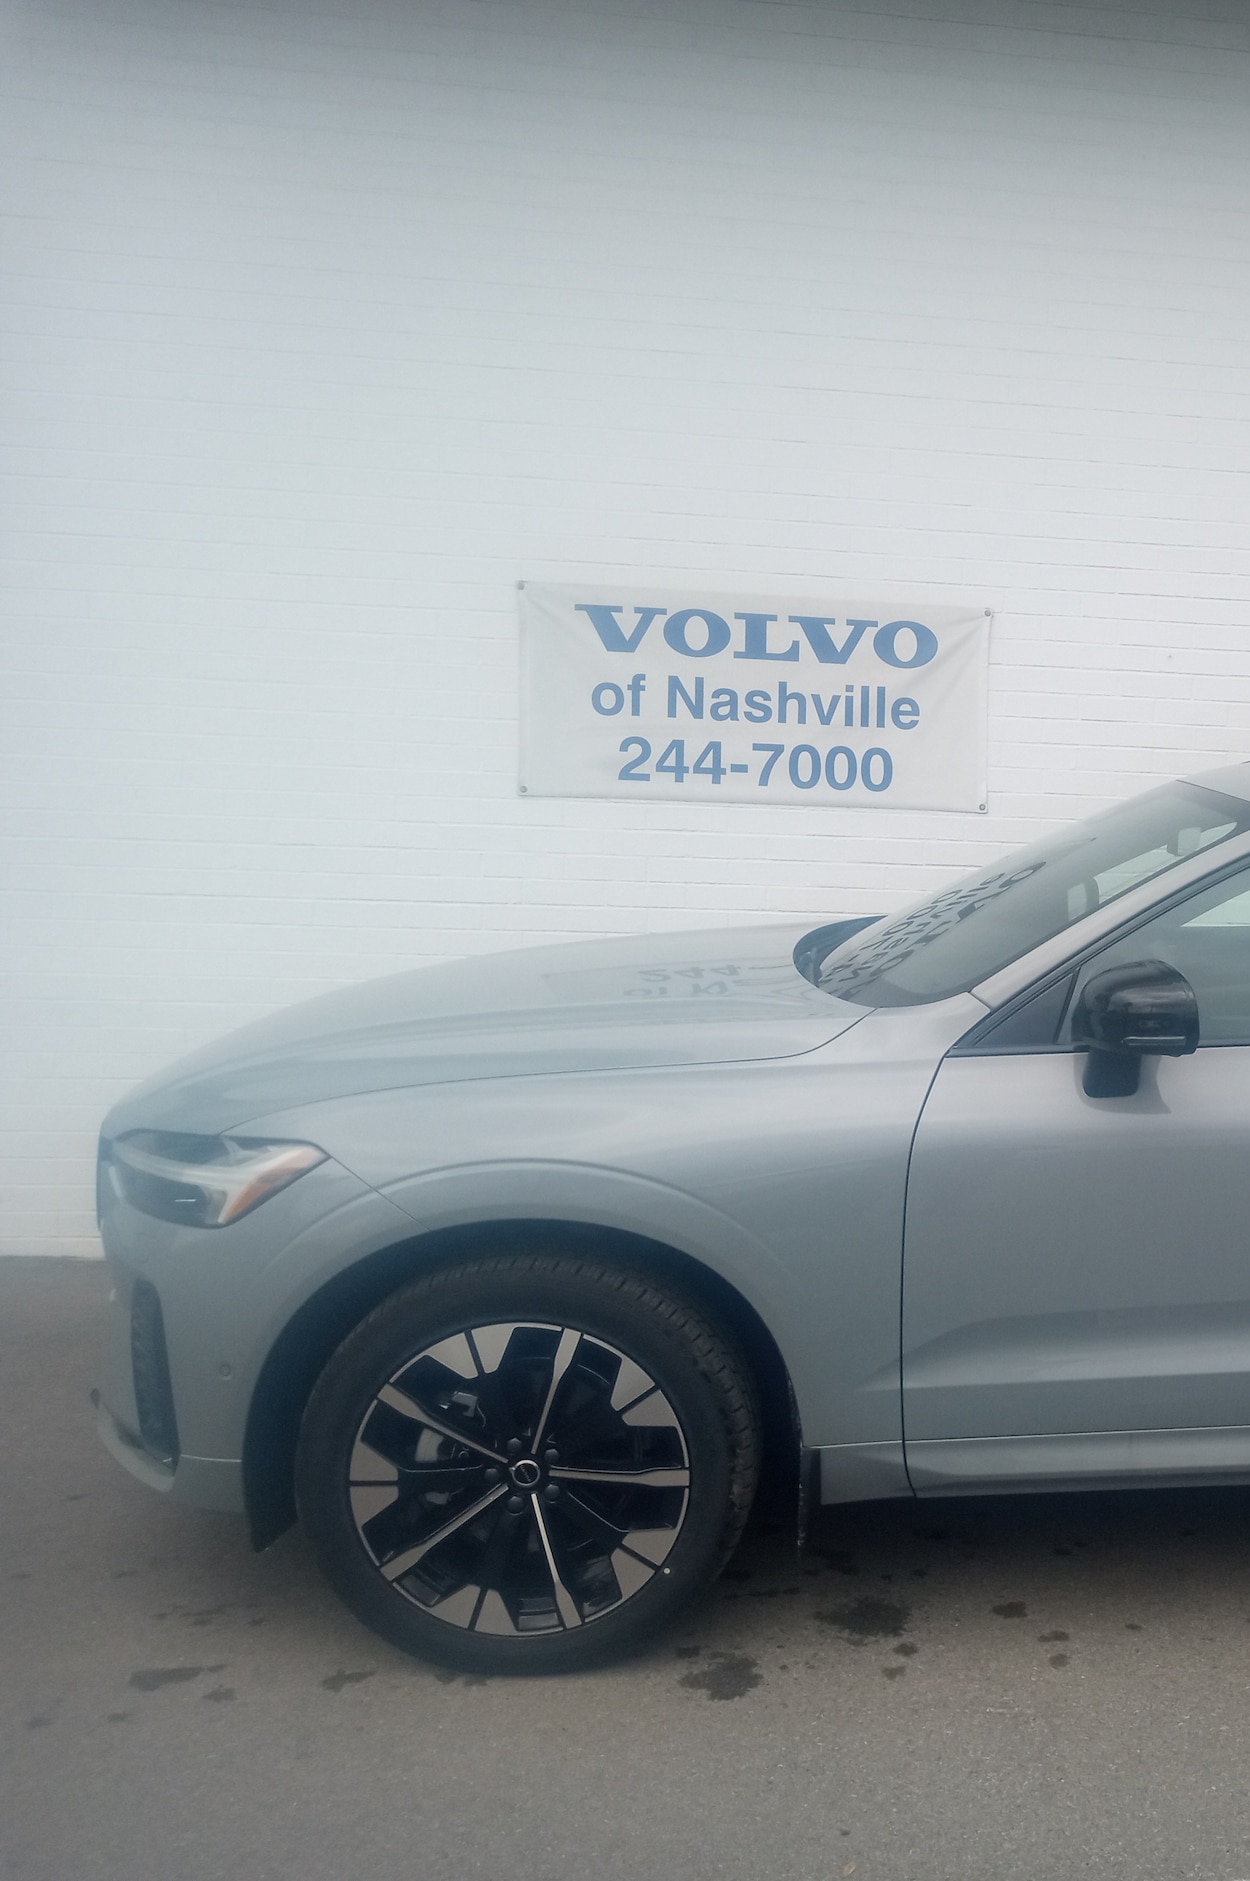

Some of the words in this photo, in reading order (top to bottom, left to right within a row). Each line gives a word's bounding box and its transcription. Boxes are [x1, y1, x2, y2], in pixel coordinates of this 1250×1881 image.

[574, 603, 939, 669] VOLVO
[591, 673, 647, 717] of
[667, 674, 921, 730] Nashville
[617, 735, 894, 792] 244-7000
